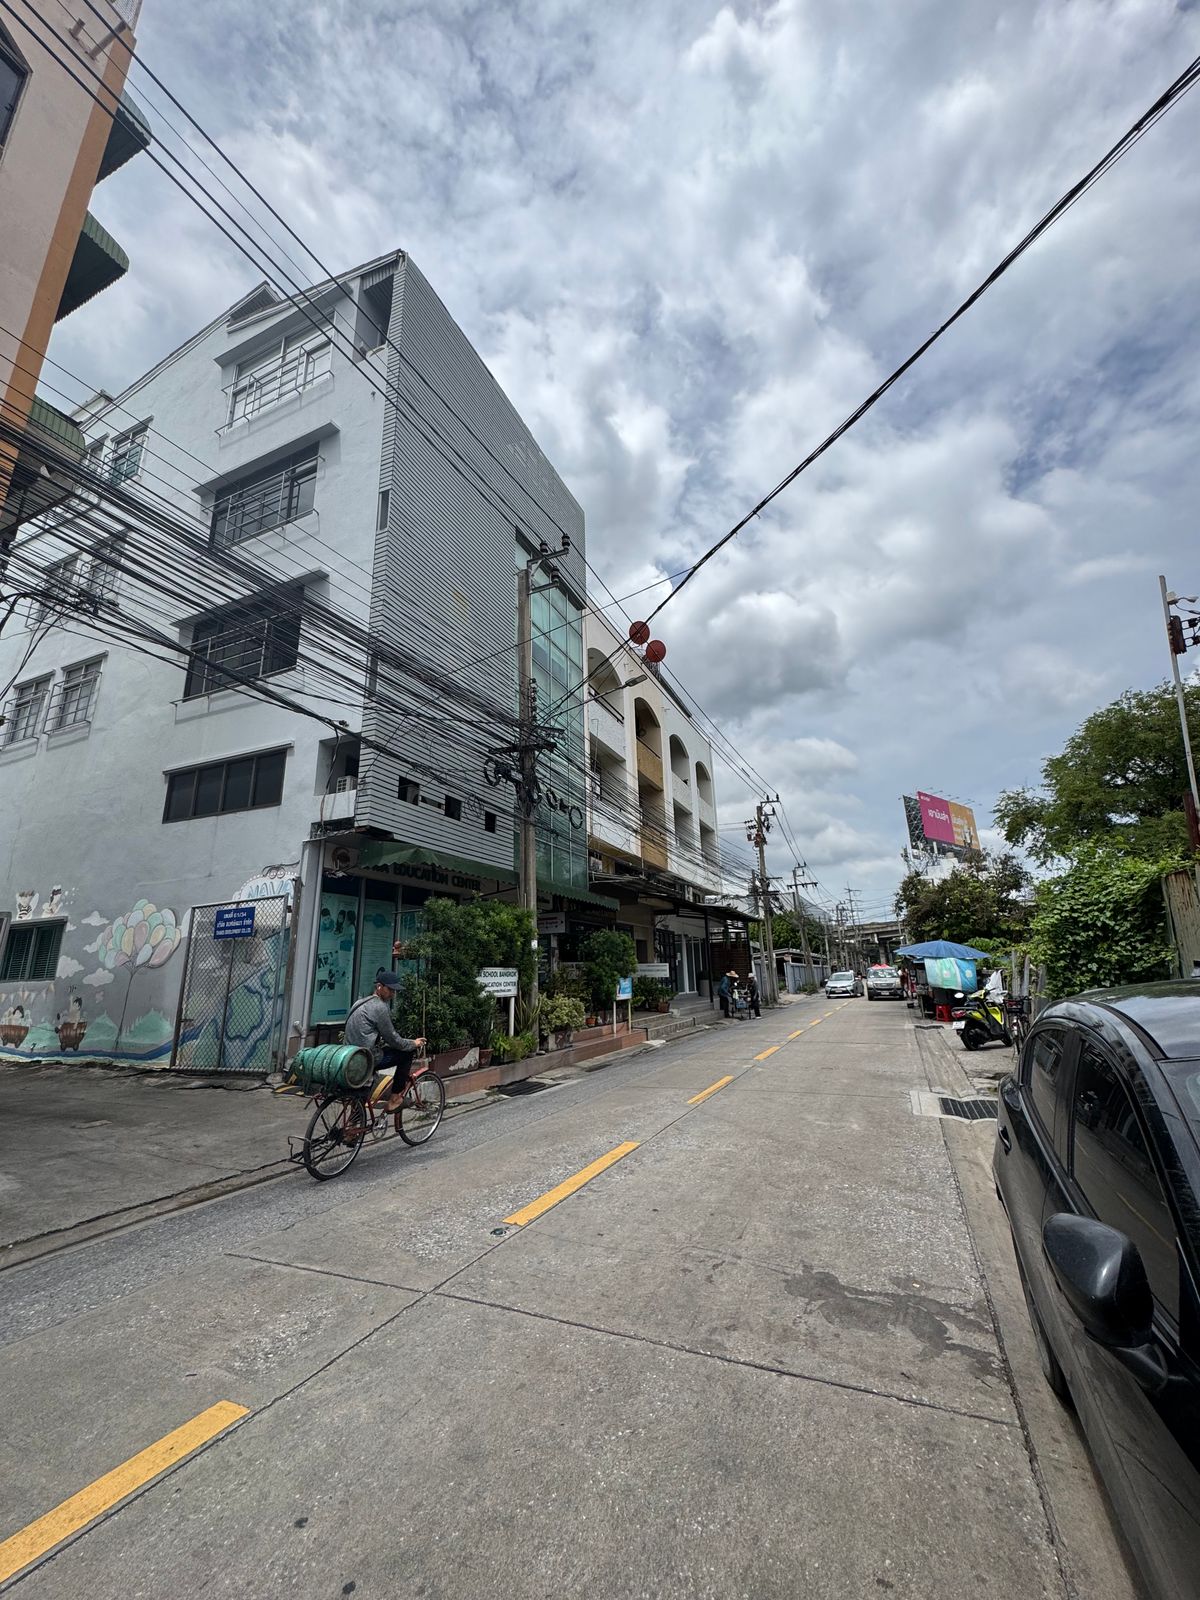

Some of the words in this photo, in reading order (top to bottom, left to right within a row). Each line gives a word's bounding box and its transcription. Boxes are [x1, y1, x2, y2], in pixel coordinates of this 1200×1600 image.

[393, 864, 449, 885] EDUCATION
[452, 875, 481, 890] CENTER
[248, 880, 294, 898] NAVA
[499, 970, 518, 978] BANGKOK
